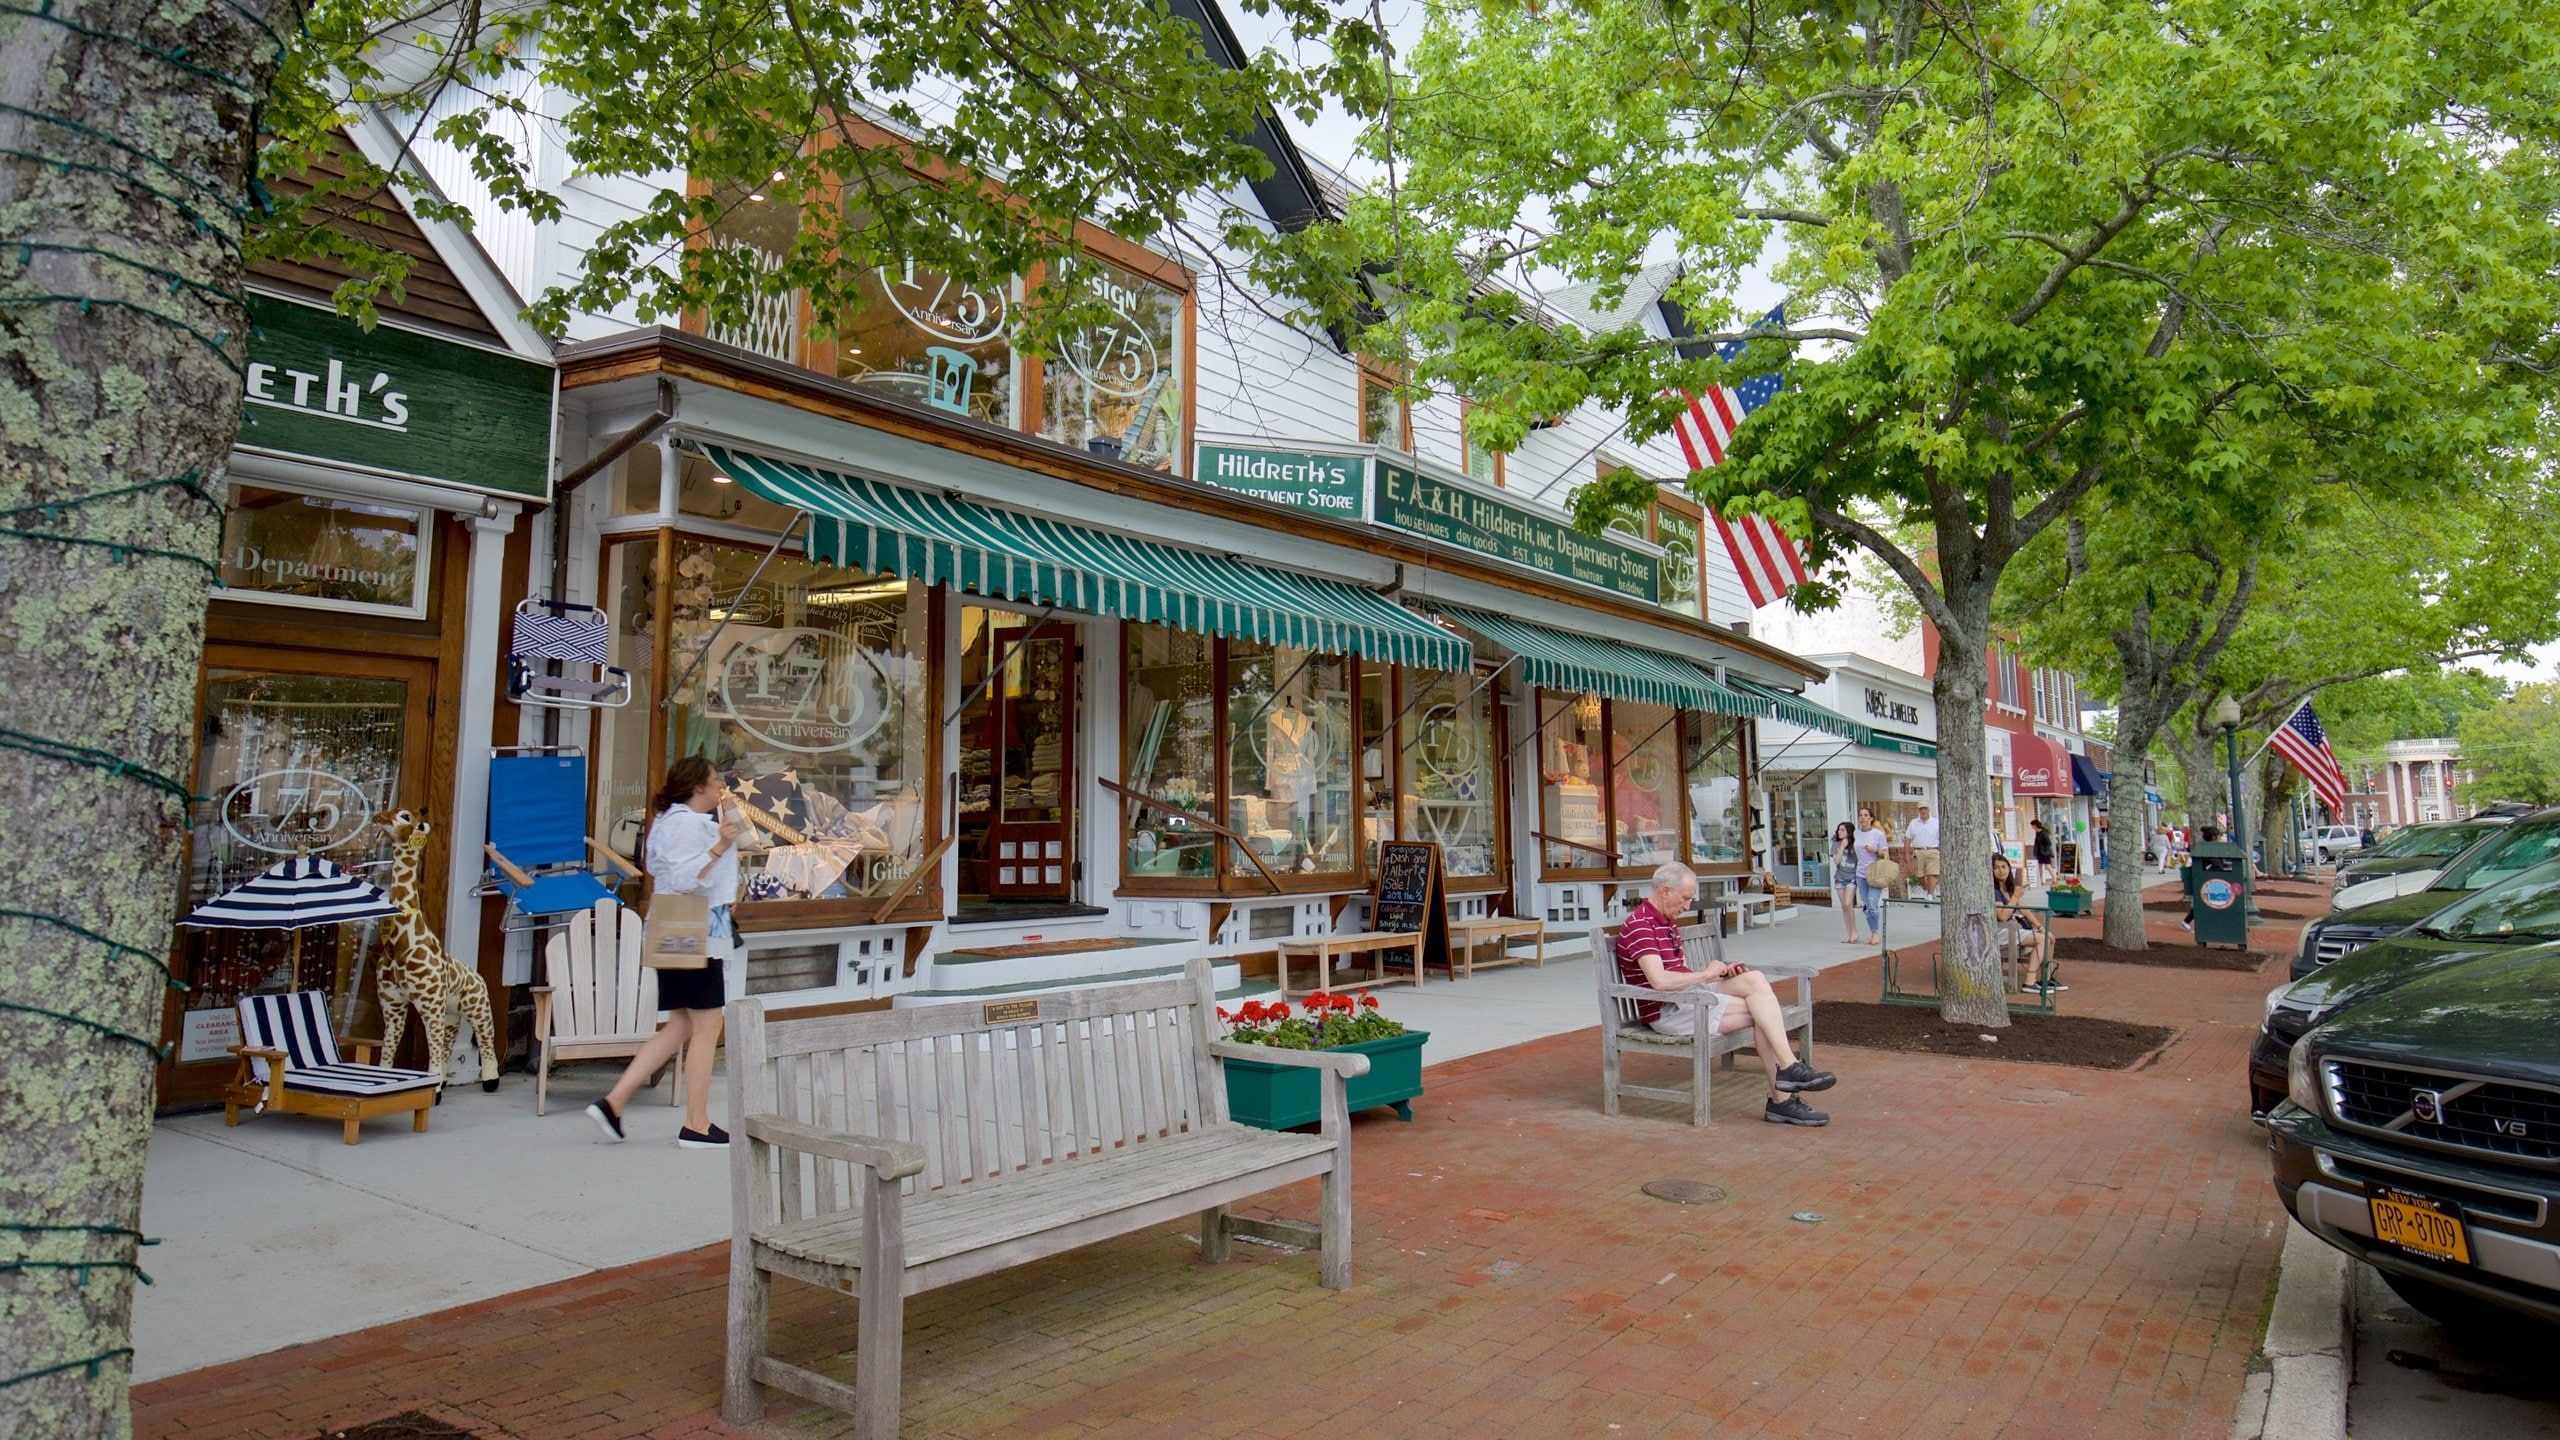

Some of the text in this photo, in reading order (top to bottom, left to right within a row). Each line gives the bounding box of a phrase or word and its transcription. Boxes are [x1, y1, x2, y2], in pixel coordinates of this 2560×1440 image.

[1431, 487, 1444, 513] &
[1450, 492, 1467, 523] H.
[236, 546, 400, 588] Department
[1534, 553, 1555, 571] 1842
[826, 606, 849, 624] 1842
[765, 722, 857, 740] Anniversary
[255, 831, 335, 845] Anniversary
[1390, 849, 1428, 864] Dash and
[872, 861, 911, 882] Gifts
[1389, 863, 1419, 877] Albert
[196, 1020, 237, 1029] CLEARANC
[2494, 1118, 2527, 1136] V8
[2388, 1191, 2437, 1212] NEW YORK
[2376, 1202, 2404, 1236] GRP
[2414, 1211, 2456, 1249] 8709
